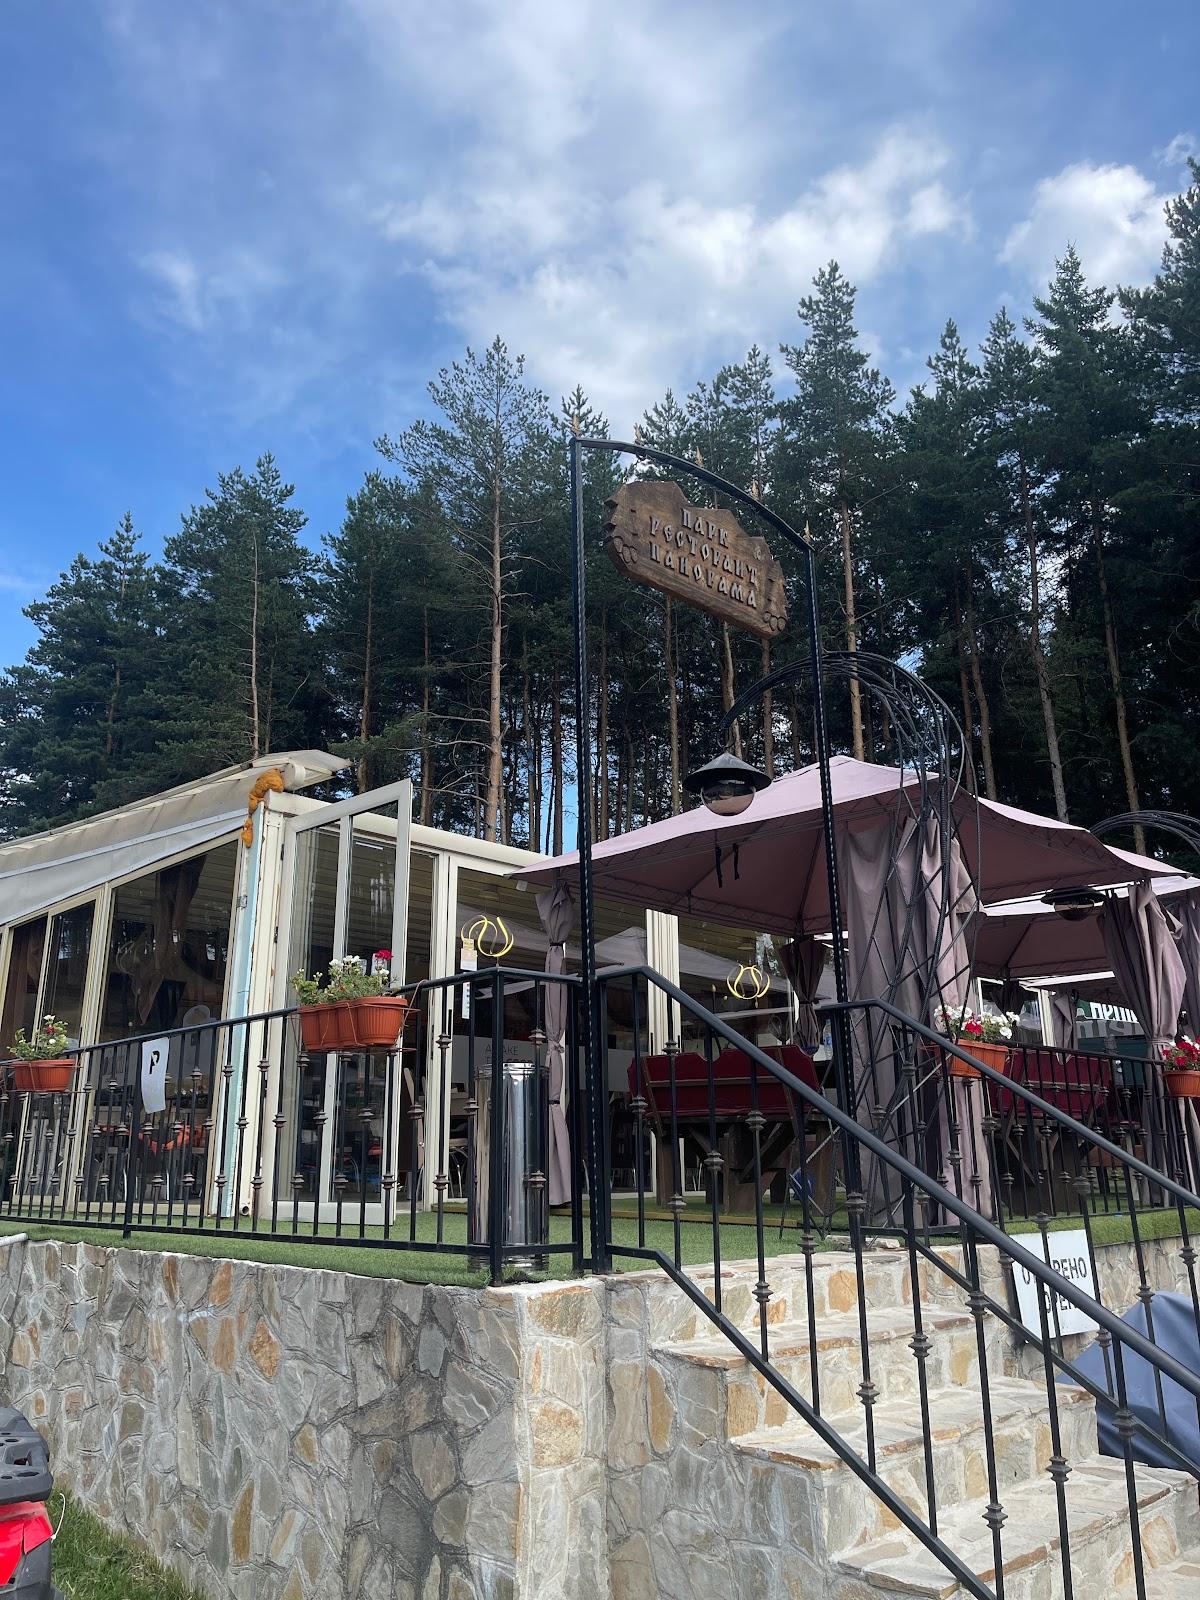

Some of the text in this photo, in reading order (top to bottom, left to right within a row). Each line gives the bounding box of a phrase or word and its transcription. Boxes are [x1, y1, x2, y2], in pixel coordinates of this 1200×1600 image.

[650, 515, 758, 586] РЕСТОРАНТ
[682, 508, 728, 548] ПАРК
[650, 541, 758, 609] ПАНОРАМА
